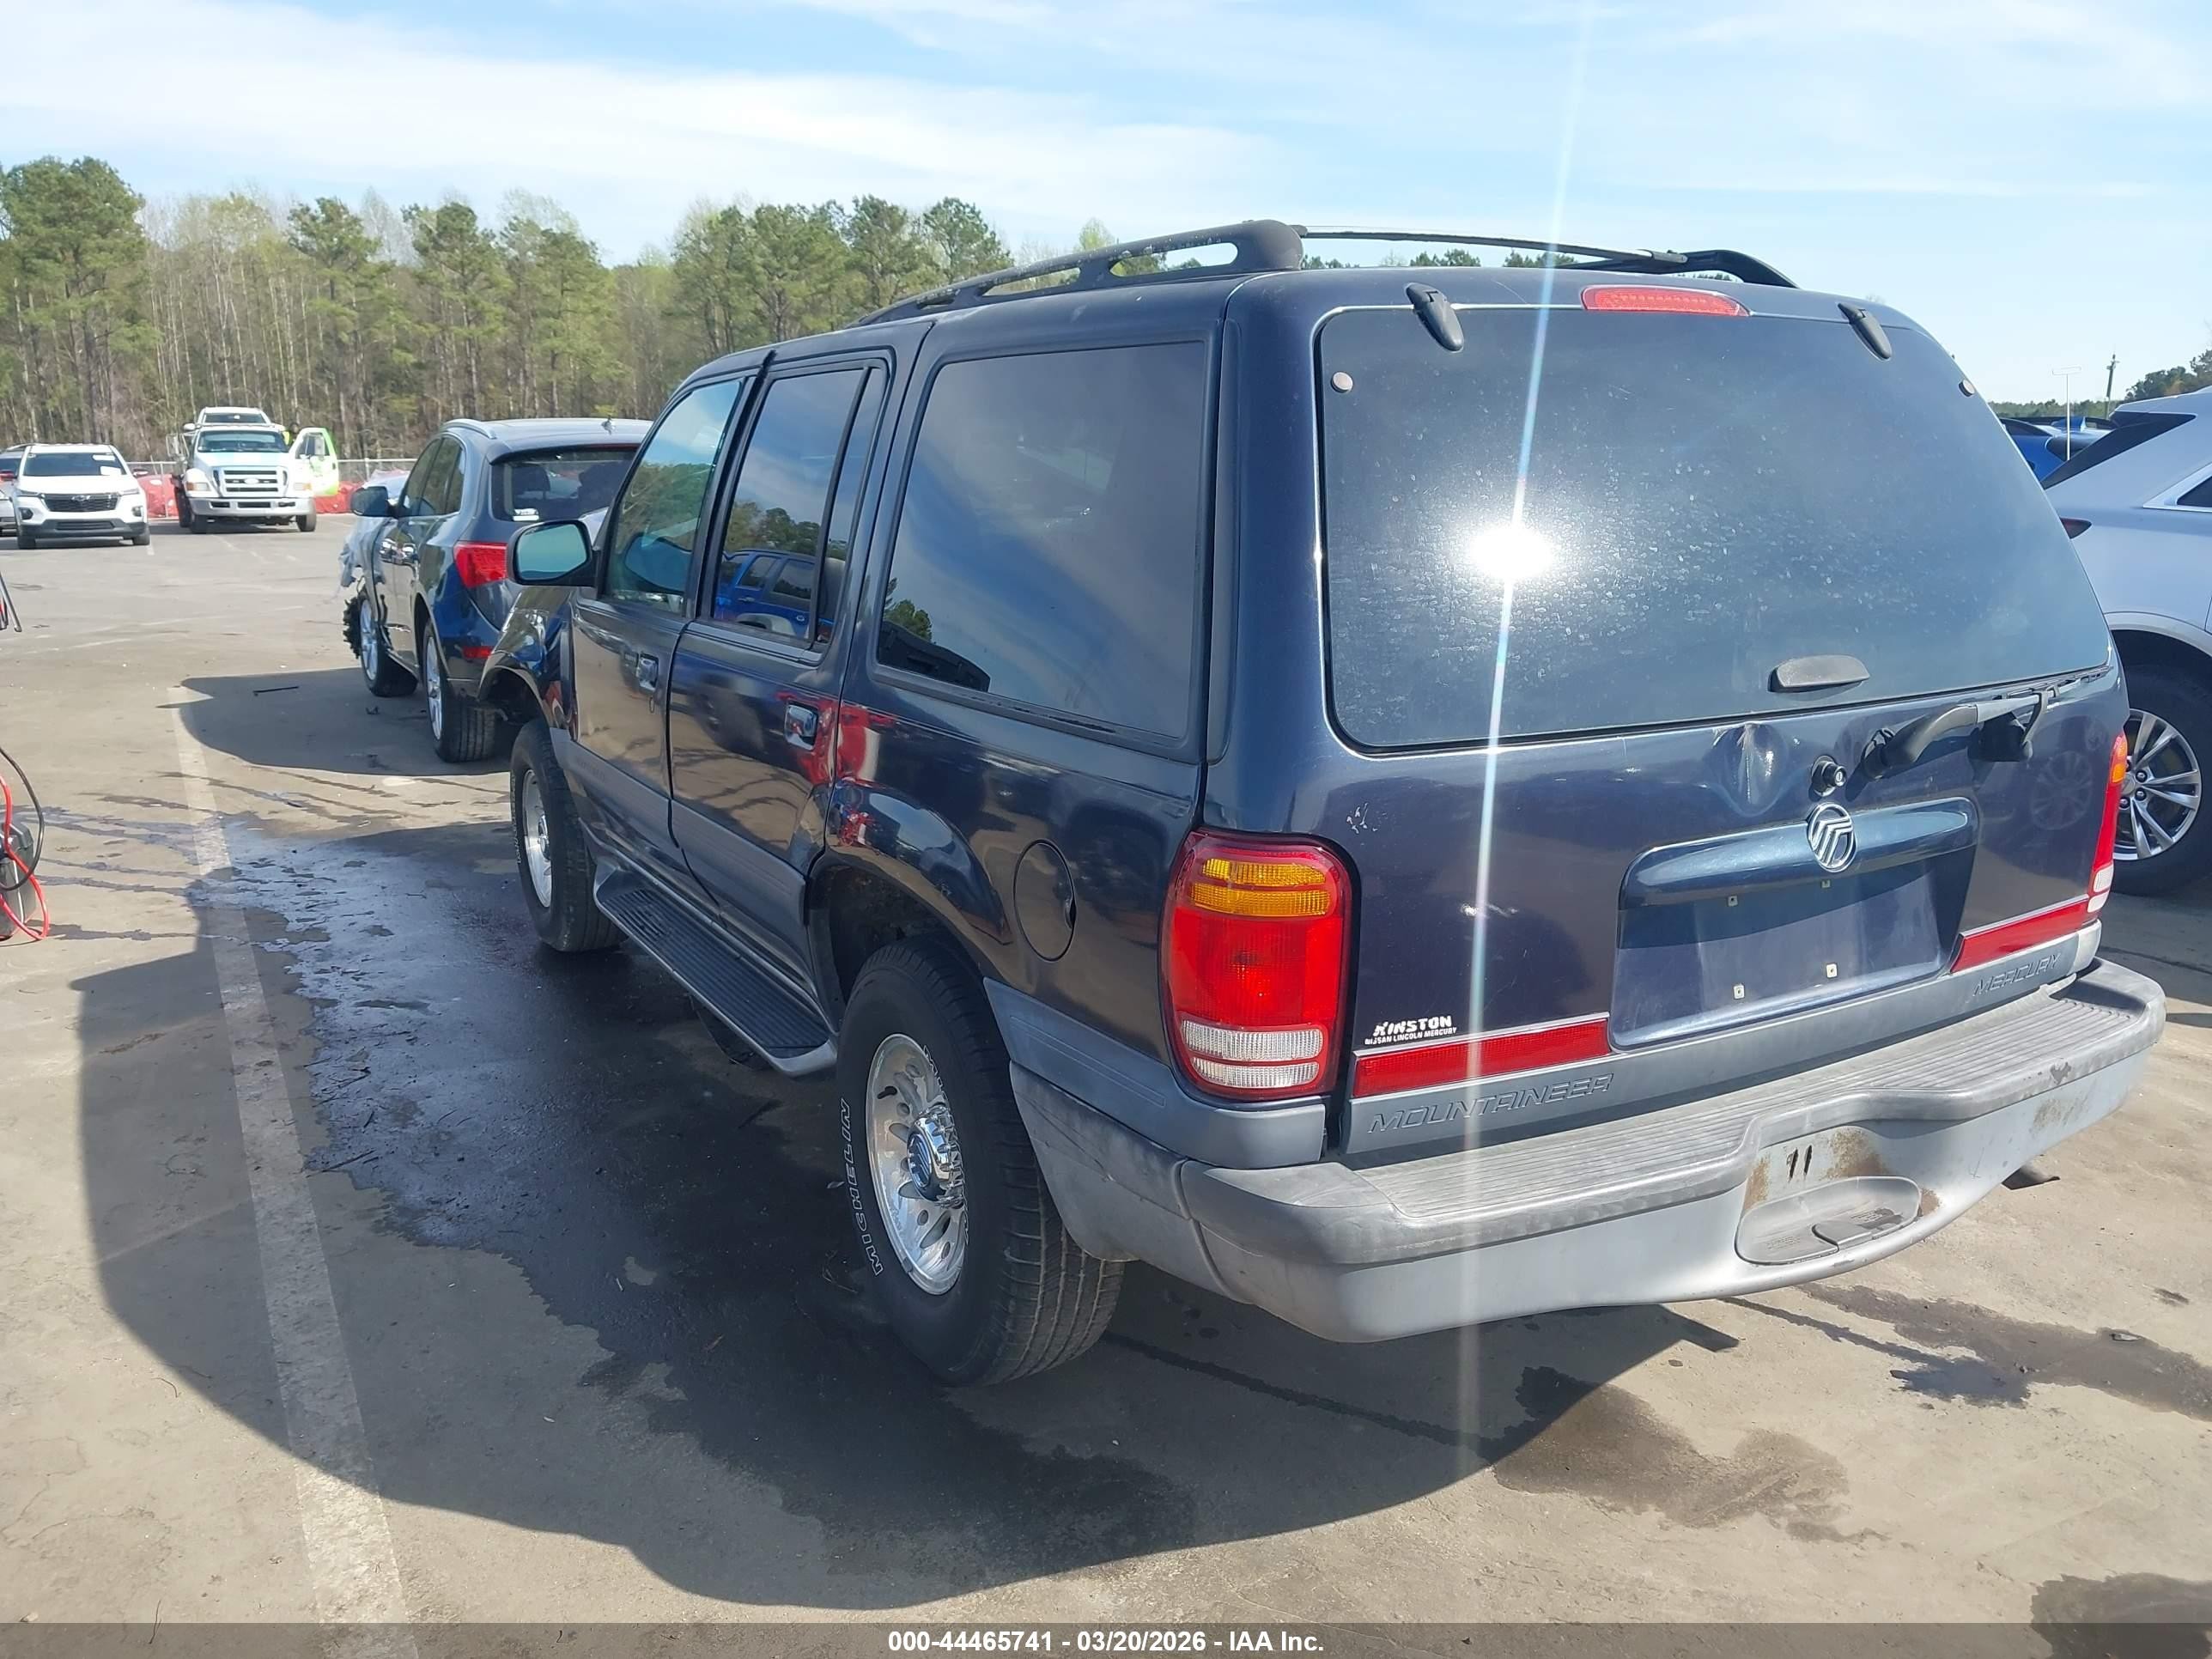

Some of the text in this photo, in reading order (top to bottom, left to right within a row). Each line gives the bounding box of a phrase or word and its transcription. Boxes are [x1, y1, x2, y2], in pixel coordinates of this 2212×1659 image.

[1973, 952, 2061, 996] MERCURY
[1373, 1015, 1453, 1036] KINSTON
[1393, 1031, 1423, 1042] LINCOLN
[1424, 1027, 1457, 1038] MERCURY
[1367, 1073, 1614, 1134] MOUNTAINEER
[840, 1097, 884, 1277] MICHELIN
